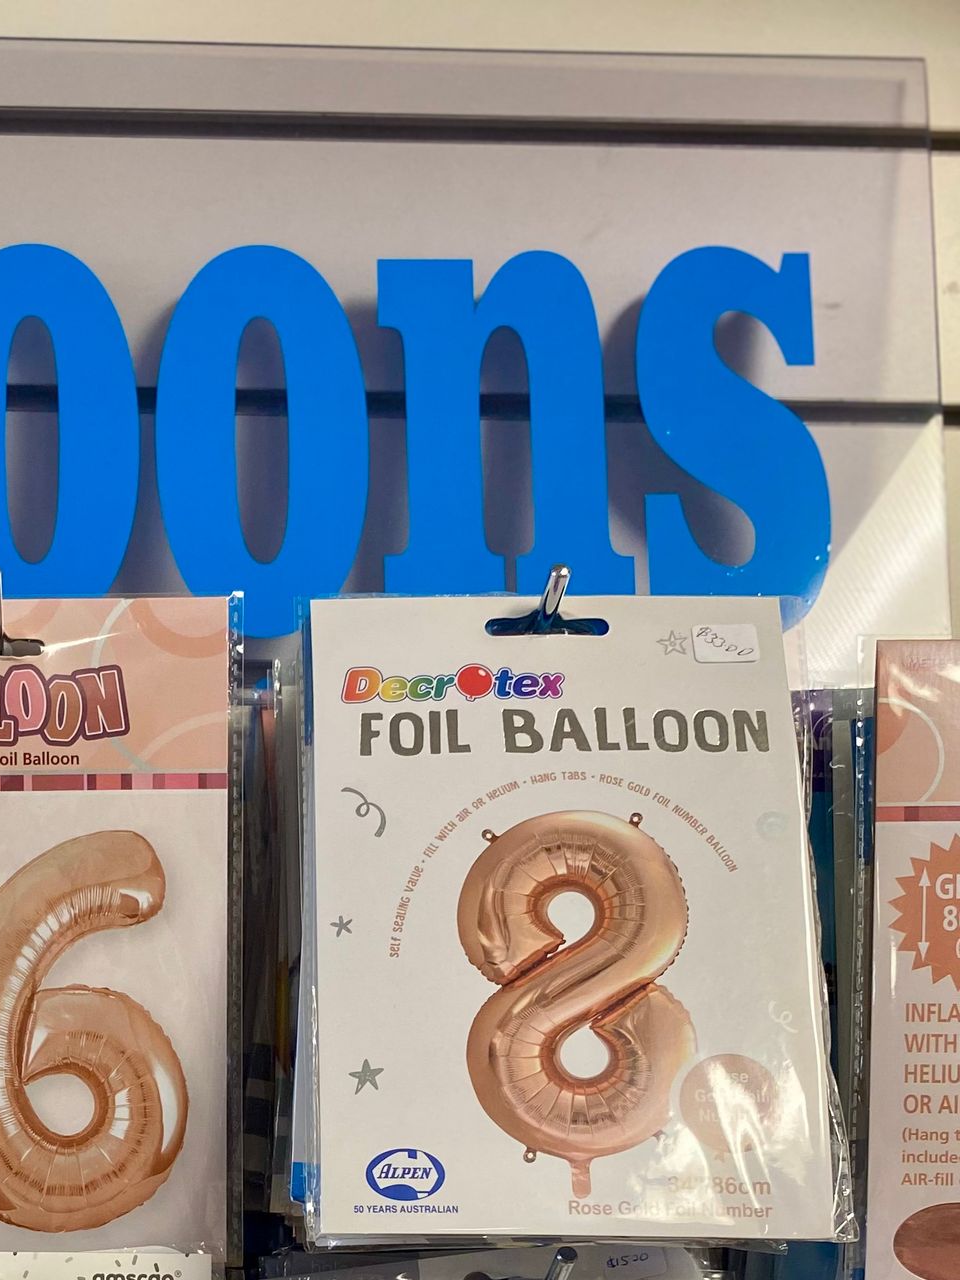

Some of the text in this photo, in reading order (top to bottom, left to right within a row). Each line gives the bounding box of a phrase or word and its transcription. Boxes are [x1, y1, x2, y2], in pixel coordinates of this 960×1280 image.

[359, 706, 770, 757] FOIL BALLOON
[22, 751, 80, 767] Balloon
[903, 1094, 932, 1115] OR
[901, 1127, 950, 1144] (Hang
[377, 1163, 433, 1180] ALPEN
[901, 1172, 954, 1187] AIR-fill
[353, 1205, 459, 1214] 50 YEARS AUSTRALIAN
[568, 1200, 613, 1216] Rose
[618, 1201, 659, 1217] Gold
